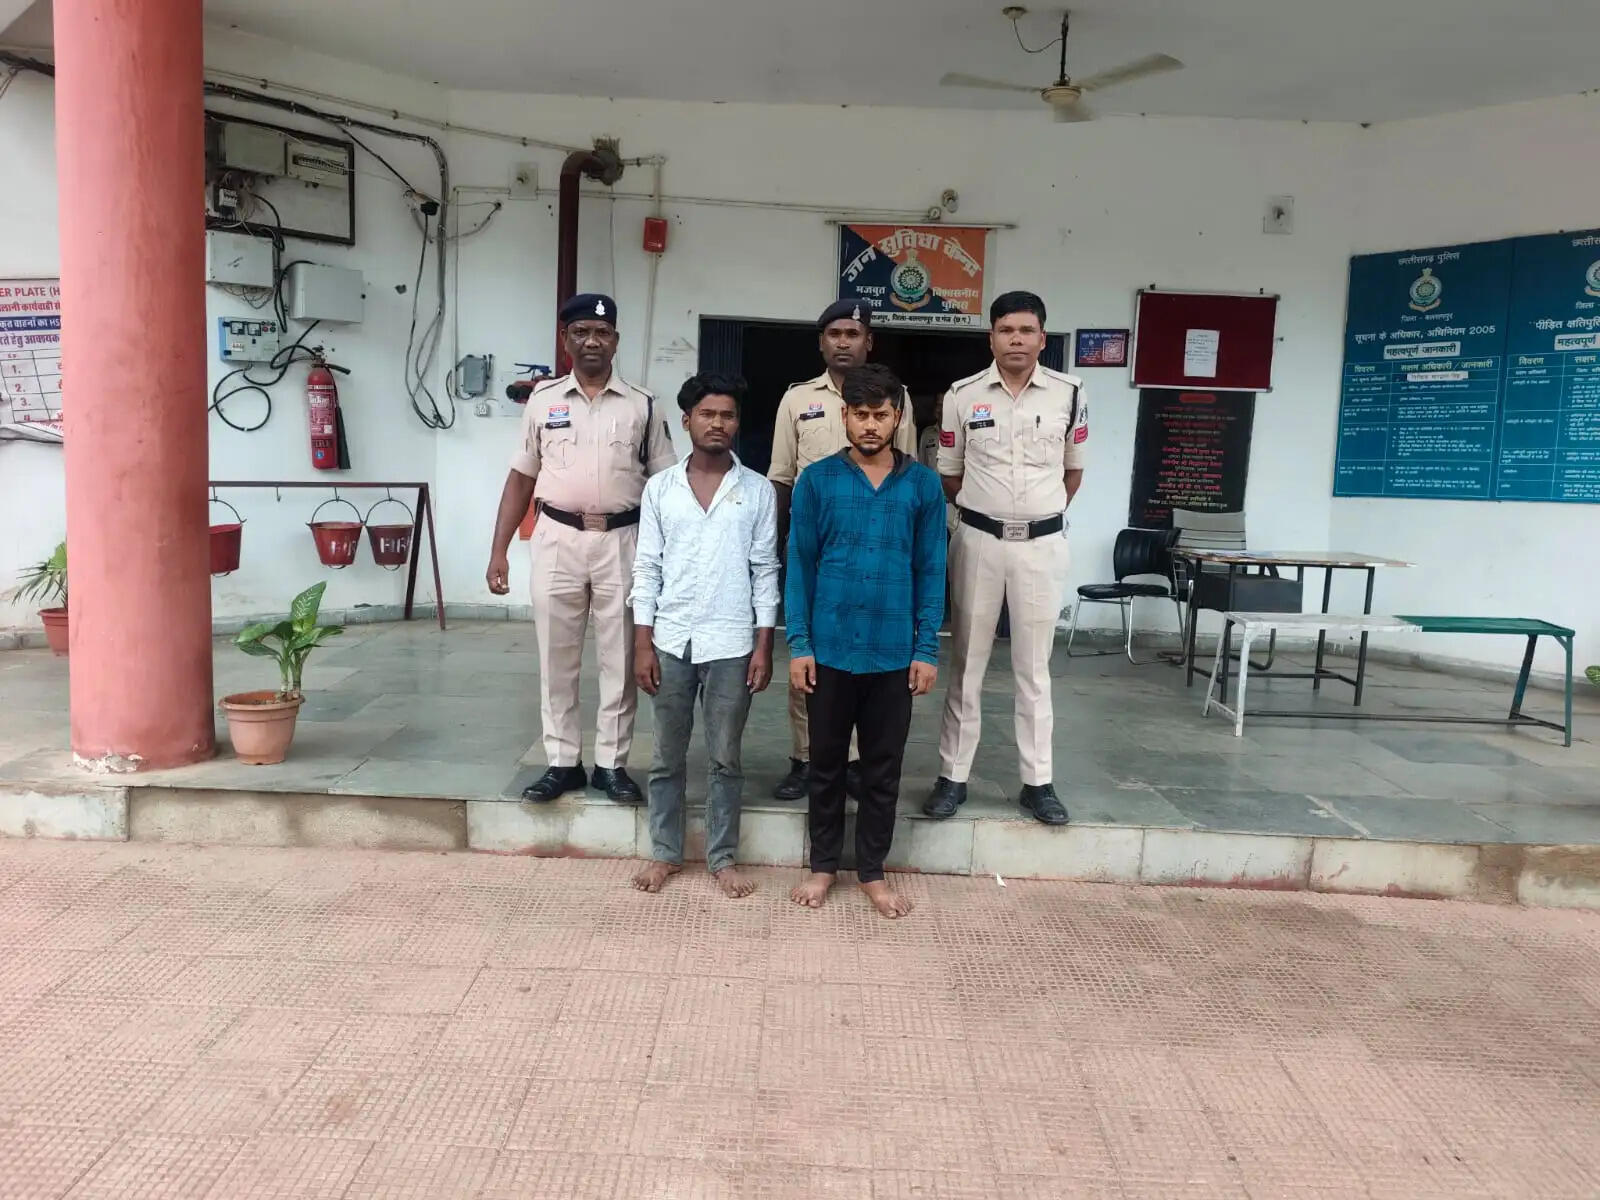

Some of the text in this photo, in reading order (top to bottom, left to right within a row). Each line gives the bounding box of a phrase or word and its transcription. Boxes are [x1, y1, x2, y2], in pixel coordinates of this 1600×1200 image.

[841, 244, 877, 282] जन
[14, 286, 46, 297] PLATE
[941, 299, 968, 311] पुलिस
[1379, 331, 1386, 340] के
[1427, 326, 1466, 336] अधिनियम
[1469, 325, 1496, 335] 2005
[1422, 343, 1456, 353] जानकारी
